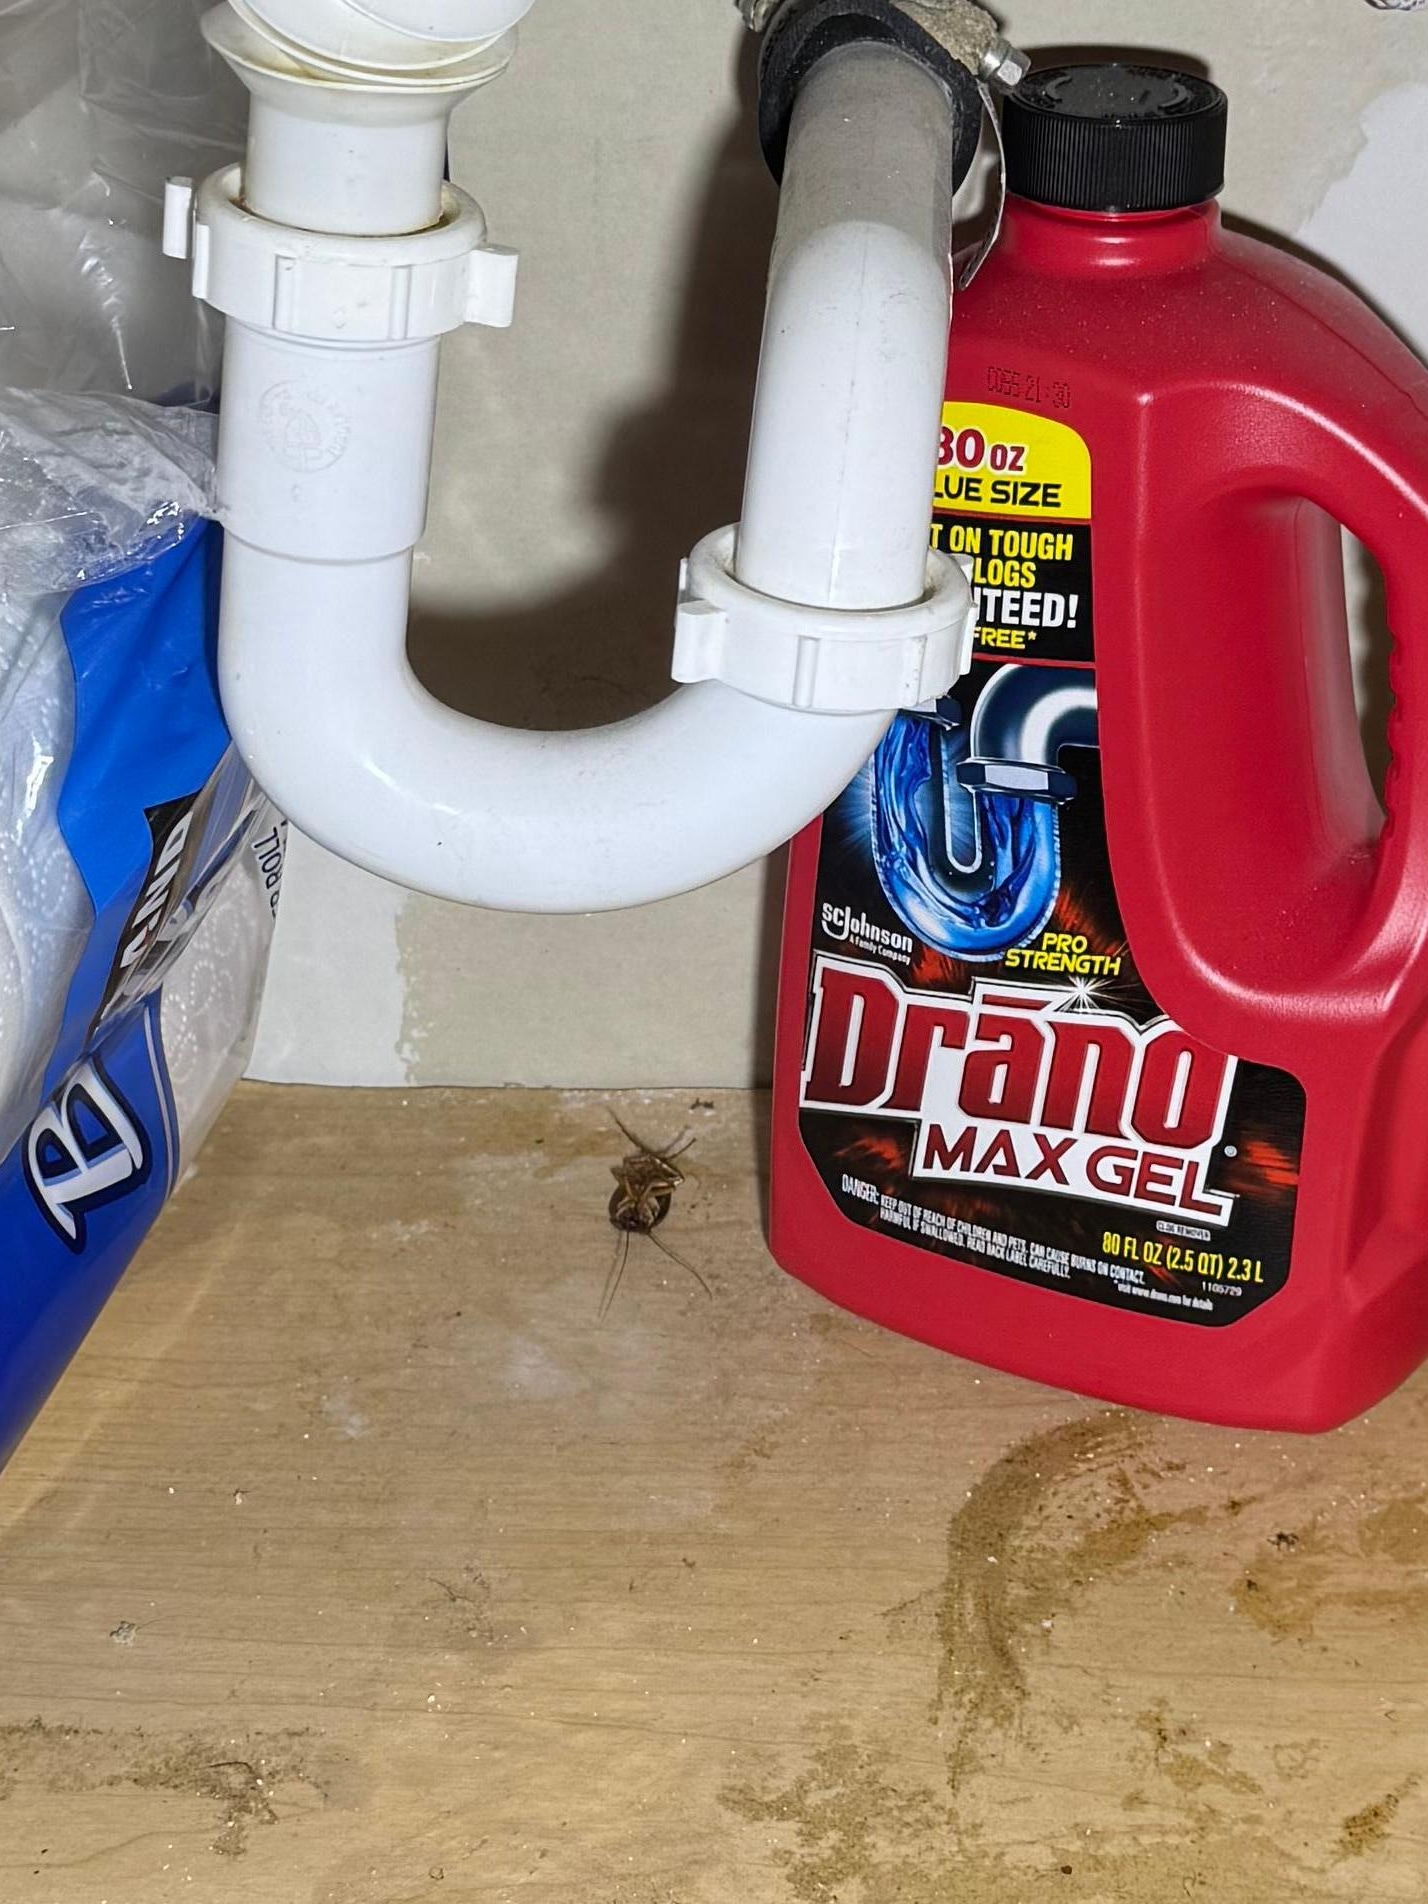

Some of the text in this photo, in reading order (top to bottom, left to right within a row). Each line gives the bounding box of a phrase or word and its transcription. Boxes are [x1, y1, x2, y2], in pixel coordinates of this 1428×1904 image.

[990, 480, 1062, 508] SIZE
[949, 525, 982, 554] ON
[988, 529, 1074, 561] TOUGH
[973, 557, 1037, 589] LOGS
[1041, 932, 1088, 954] PRO
[1004, 948, 1122, 976] STRENGTH
[922, 1123, 1223, 1217] MAX GEL
[880, 1194, 898, 1210] KEEP
[897, 1199, 912, 1215] OUT
[922, 1207, 946, 1227] REACH
[957, 1220, 992, 1241] CHILDREN
[992, 1231, 1007, 1245] AND
[1102, 1231, 1264, 1283] 80 FL OZ (2.5 QT) 2.3 L
